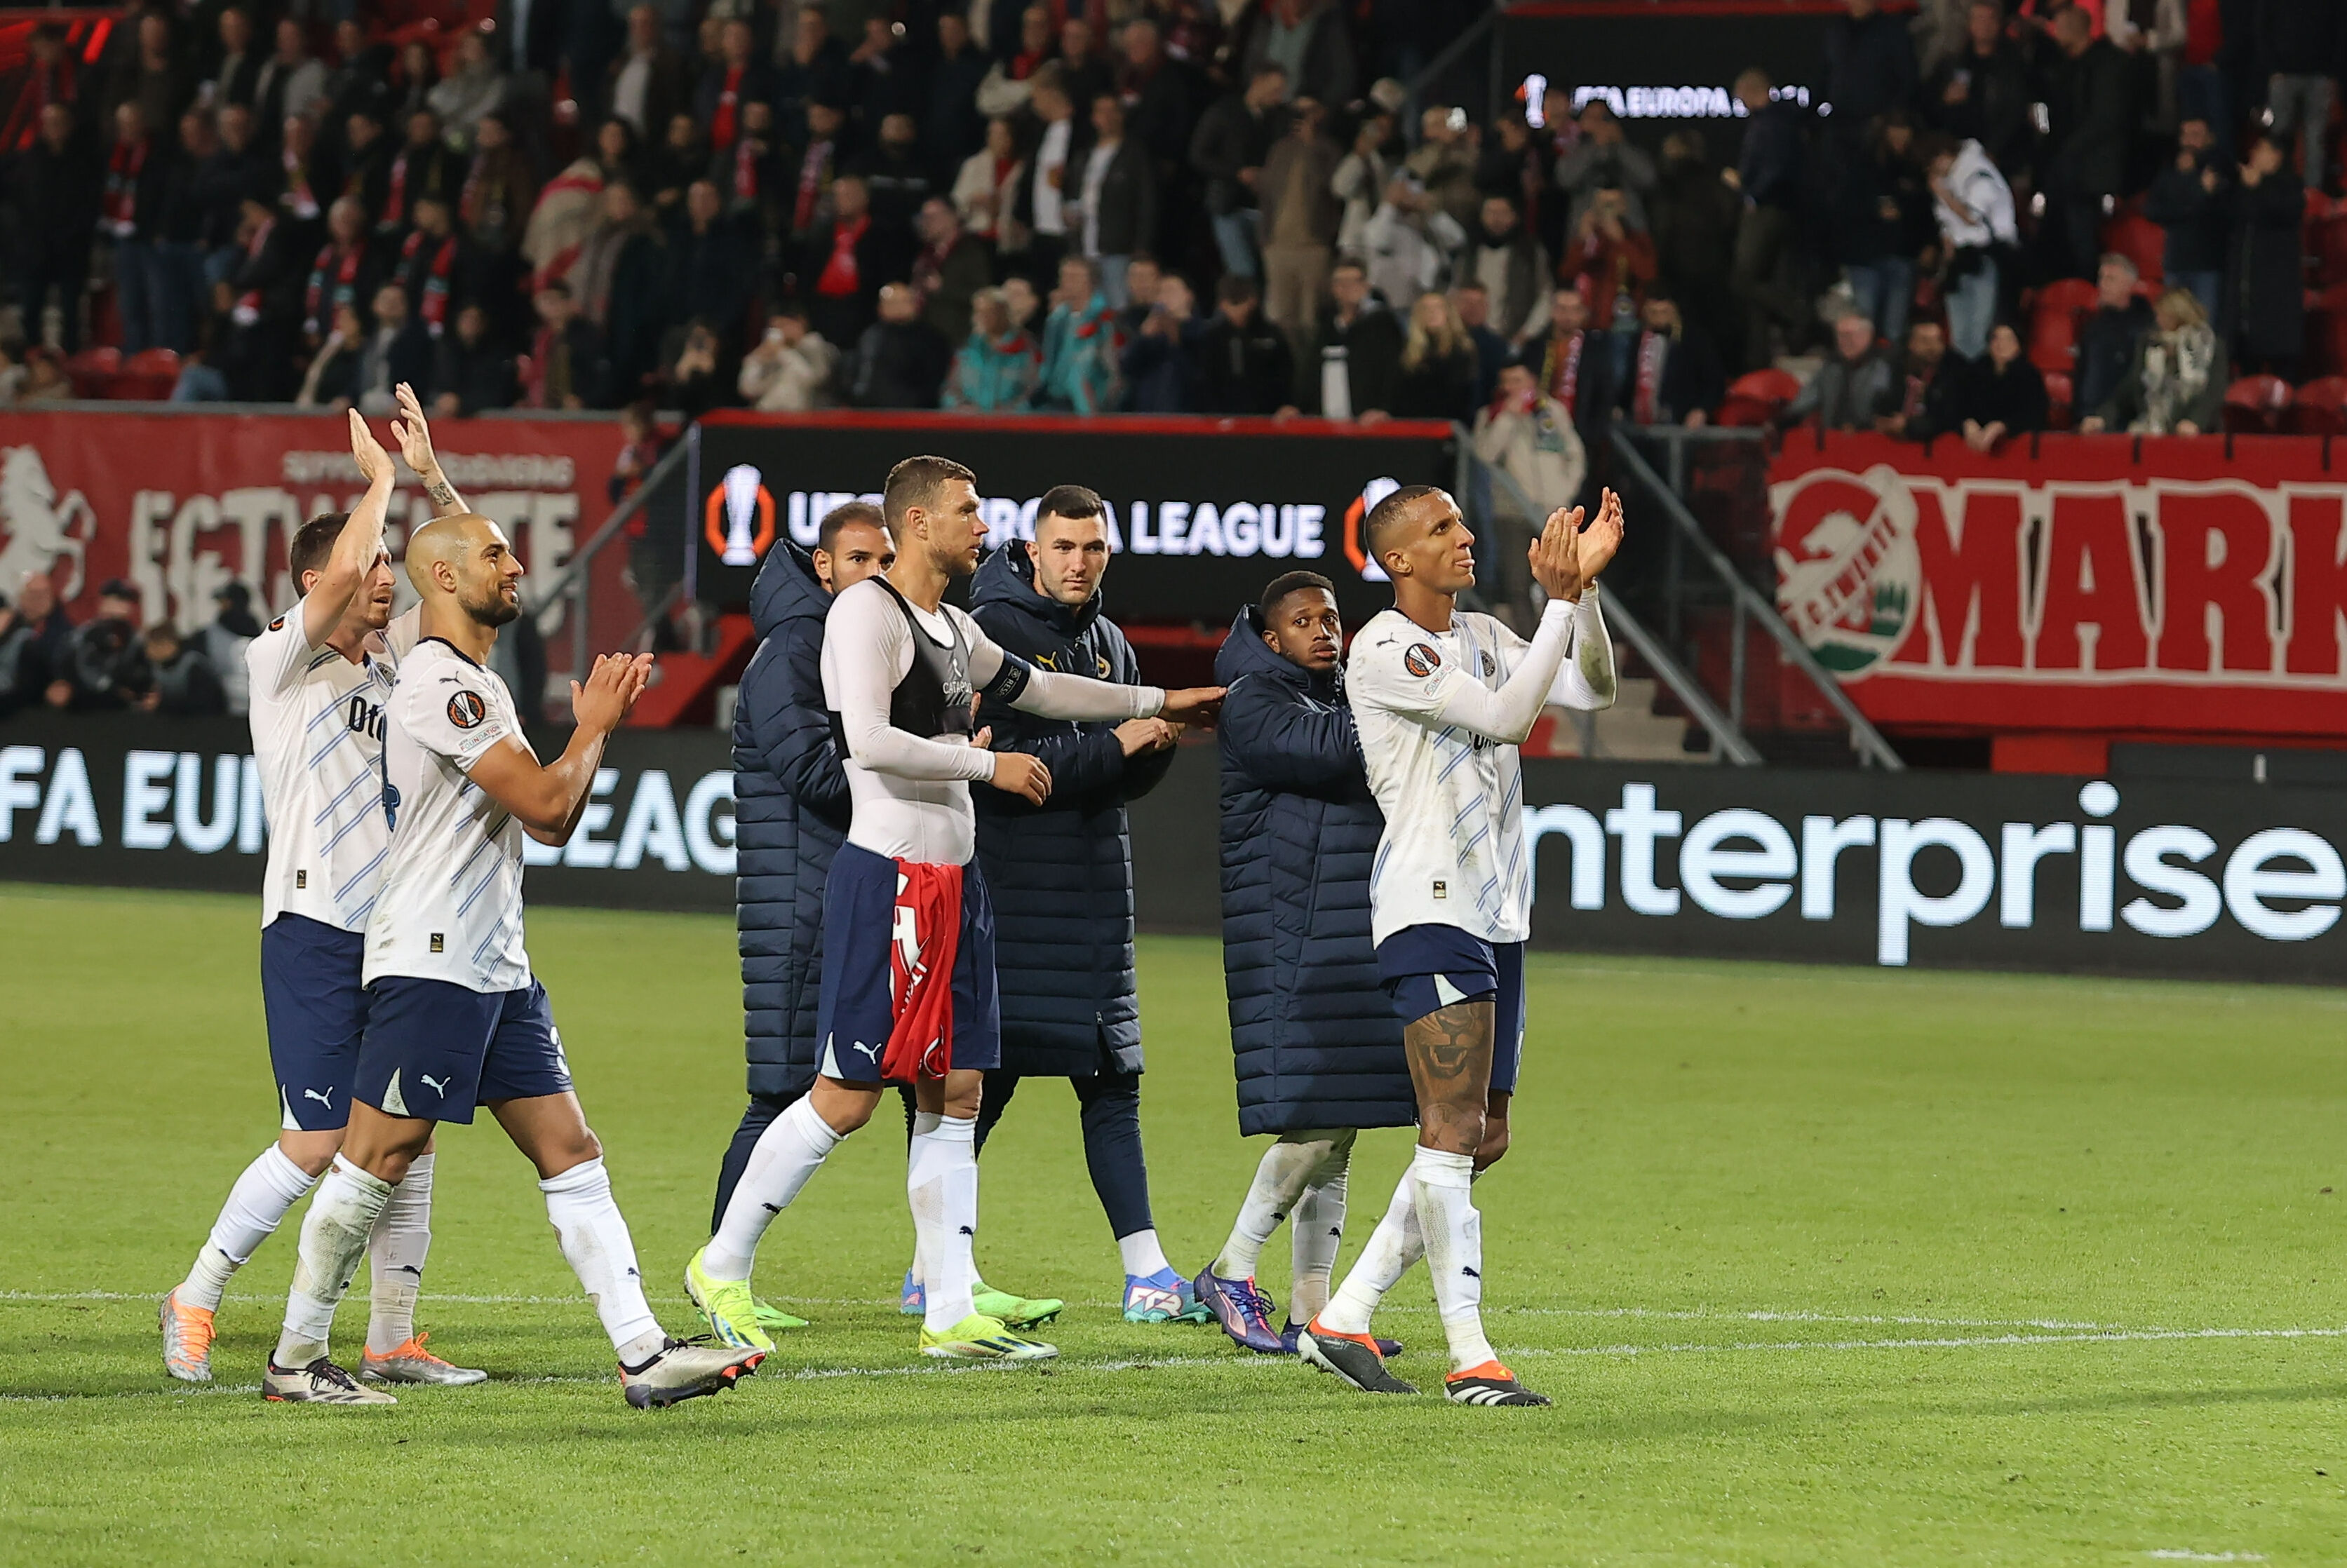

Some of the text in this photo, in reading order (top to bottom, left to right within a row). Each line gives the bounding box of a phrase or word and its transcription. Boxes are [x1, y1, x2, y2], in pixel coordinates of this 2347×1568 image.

[1626, 86, 1733, 119] EUROPA
[1129, 500, 1326, 559] LEAGUE
[1522, 780, 2347, 966] nterprise
